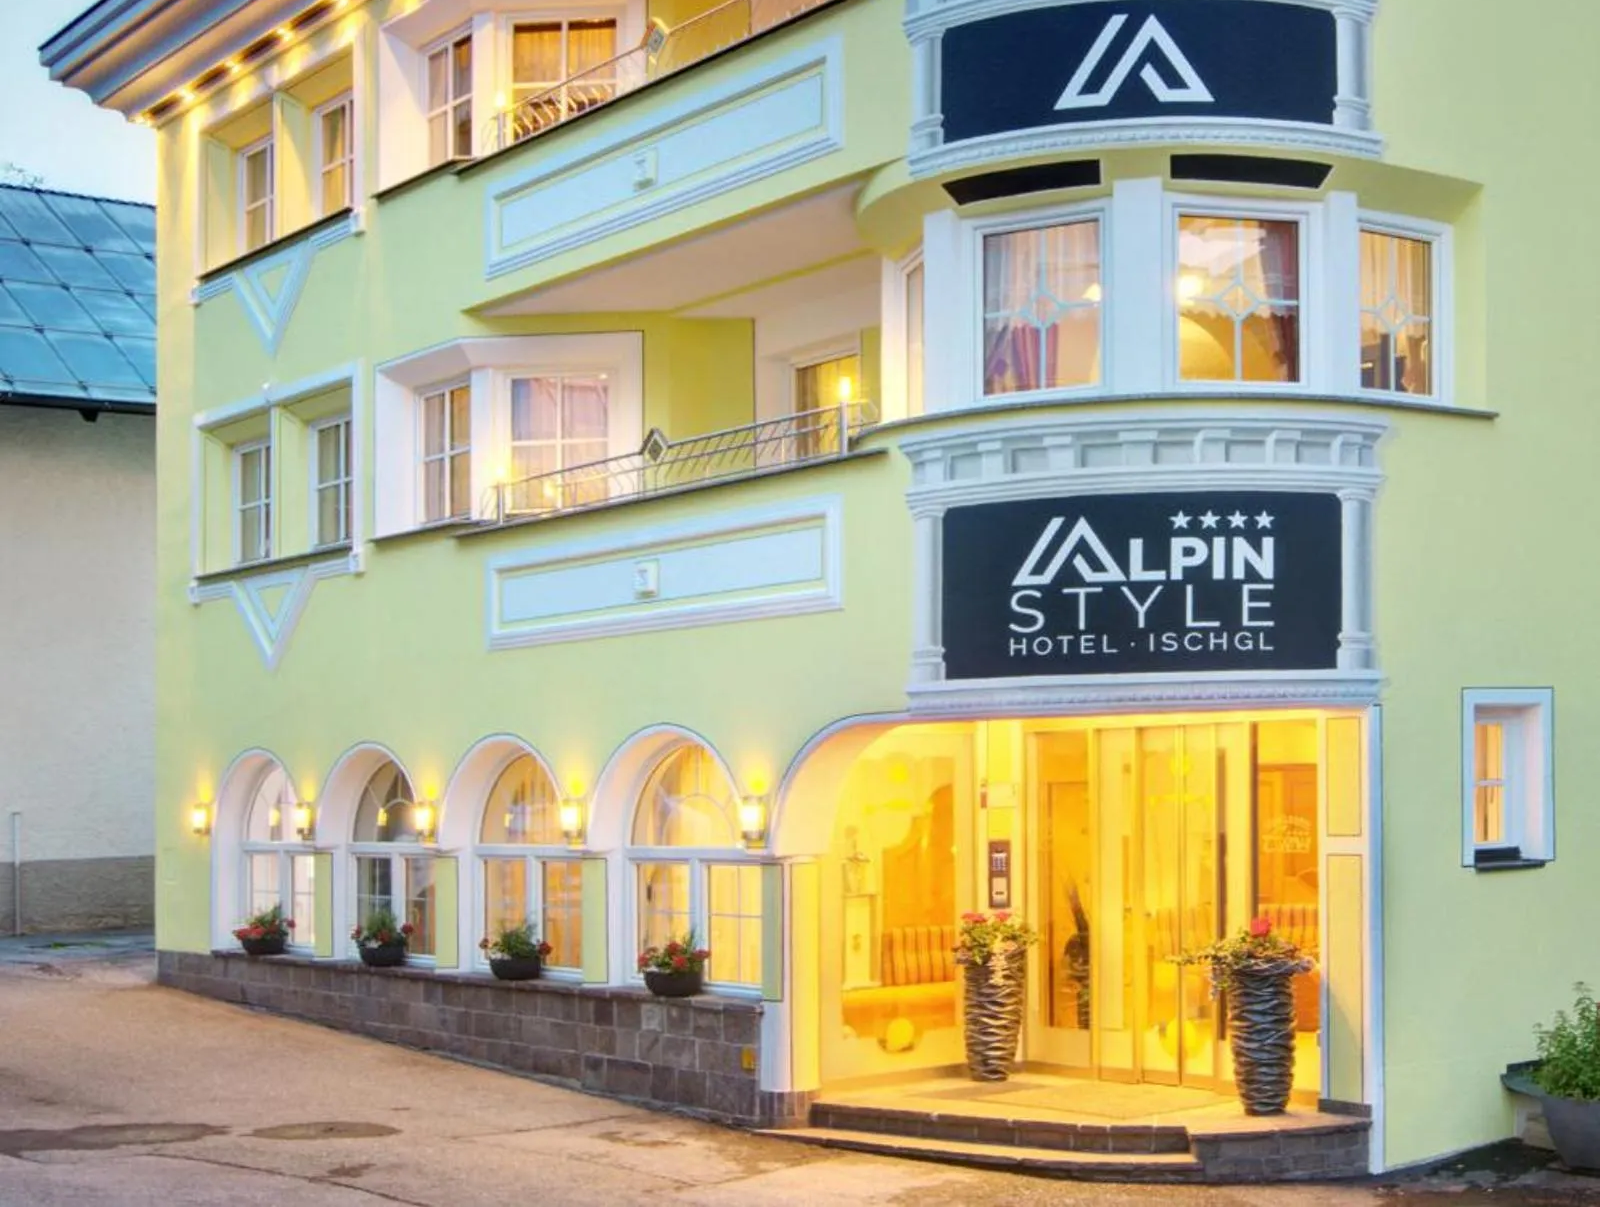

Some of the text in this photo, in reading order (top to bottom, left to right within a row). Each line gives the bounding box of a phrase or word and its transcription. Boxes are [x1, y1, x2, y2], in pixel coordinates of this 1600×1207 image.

[1011, 516, 1275, 586] ALPIN
[1008, 583, 1275, 634] STYLE
[1009, 631, 1275, 657] HOTEL ISCHGL
